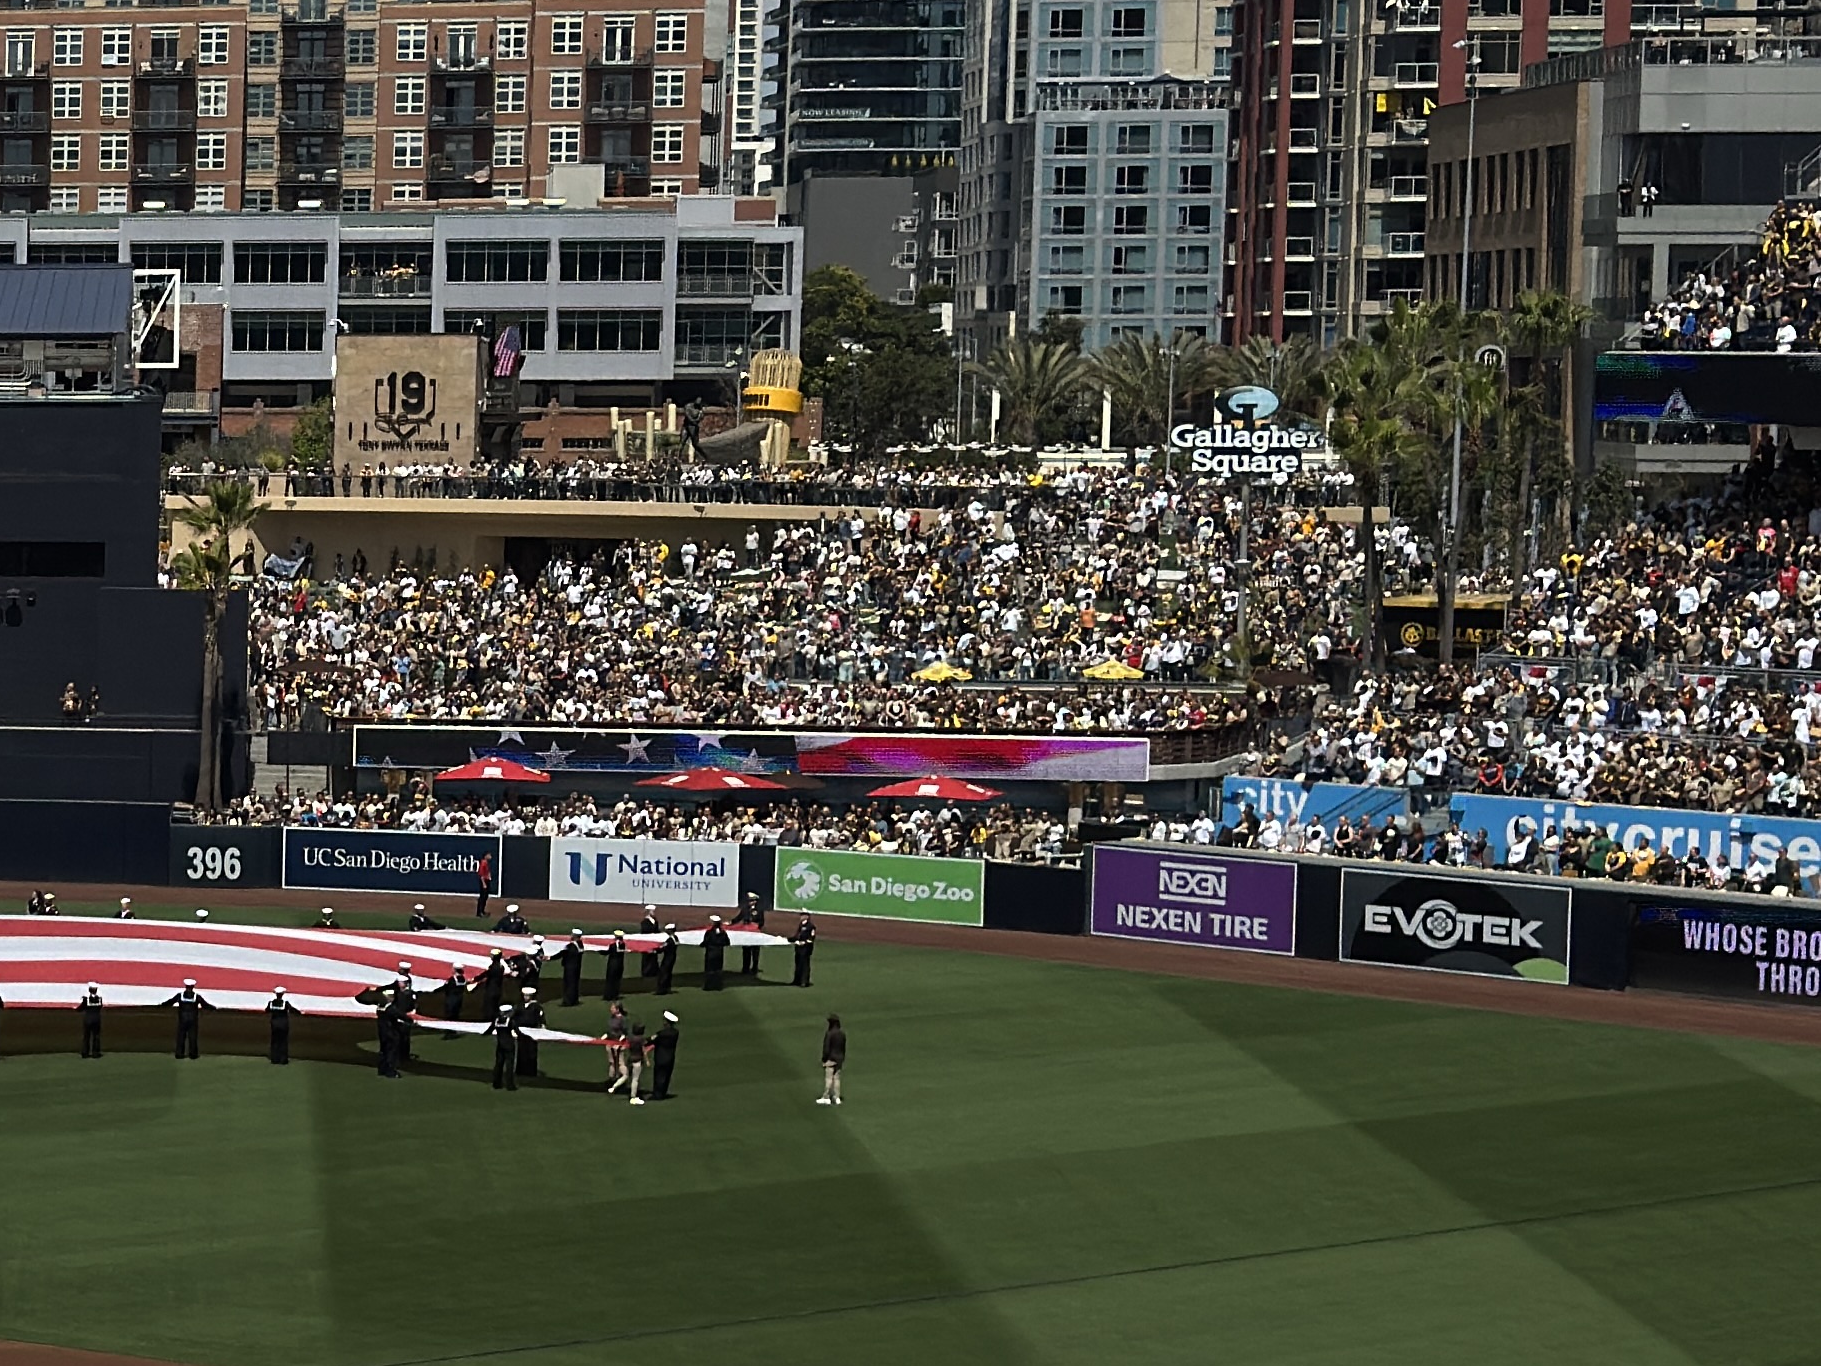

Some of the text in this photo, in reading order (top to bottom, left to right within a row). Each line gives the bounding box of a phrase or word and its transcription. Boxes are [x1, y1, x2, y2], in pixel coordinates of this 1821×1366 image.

[387, 371, 426, 414] 19
[1171, 423, 1321, 455] Gallagher
[1192, 448, 1299, 478] Square
[1238, 780, 1308, 818] city
[186, 846, 242, 881] 396
[302, 845, 481, 875] UC San Diego Health
[617, 853, 725, 879] National
[631, 876, 712, 892] UNIVERSITY
[828, 873, 974, 903] San Diego Zoo
[1158, 868, 1227, 900] NEXEN
[1116, 903, 1269, 942] NEXEN TIRE
[1365, 898, 1543, 950] EVOTEK
[1683, 918, 1821, 962] WHOSE BRO
[1756, 961, 1821, 997] THRO
